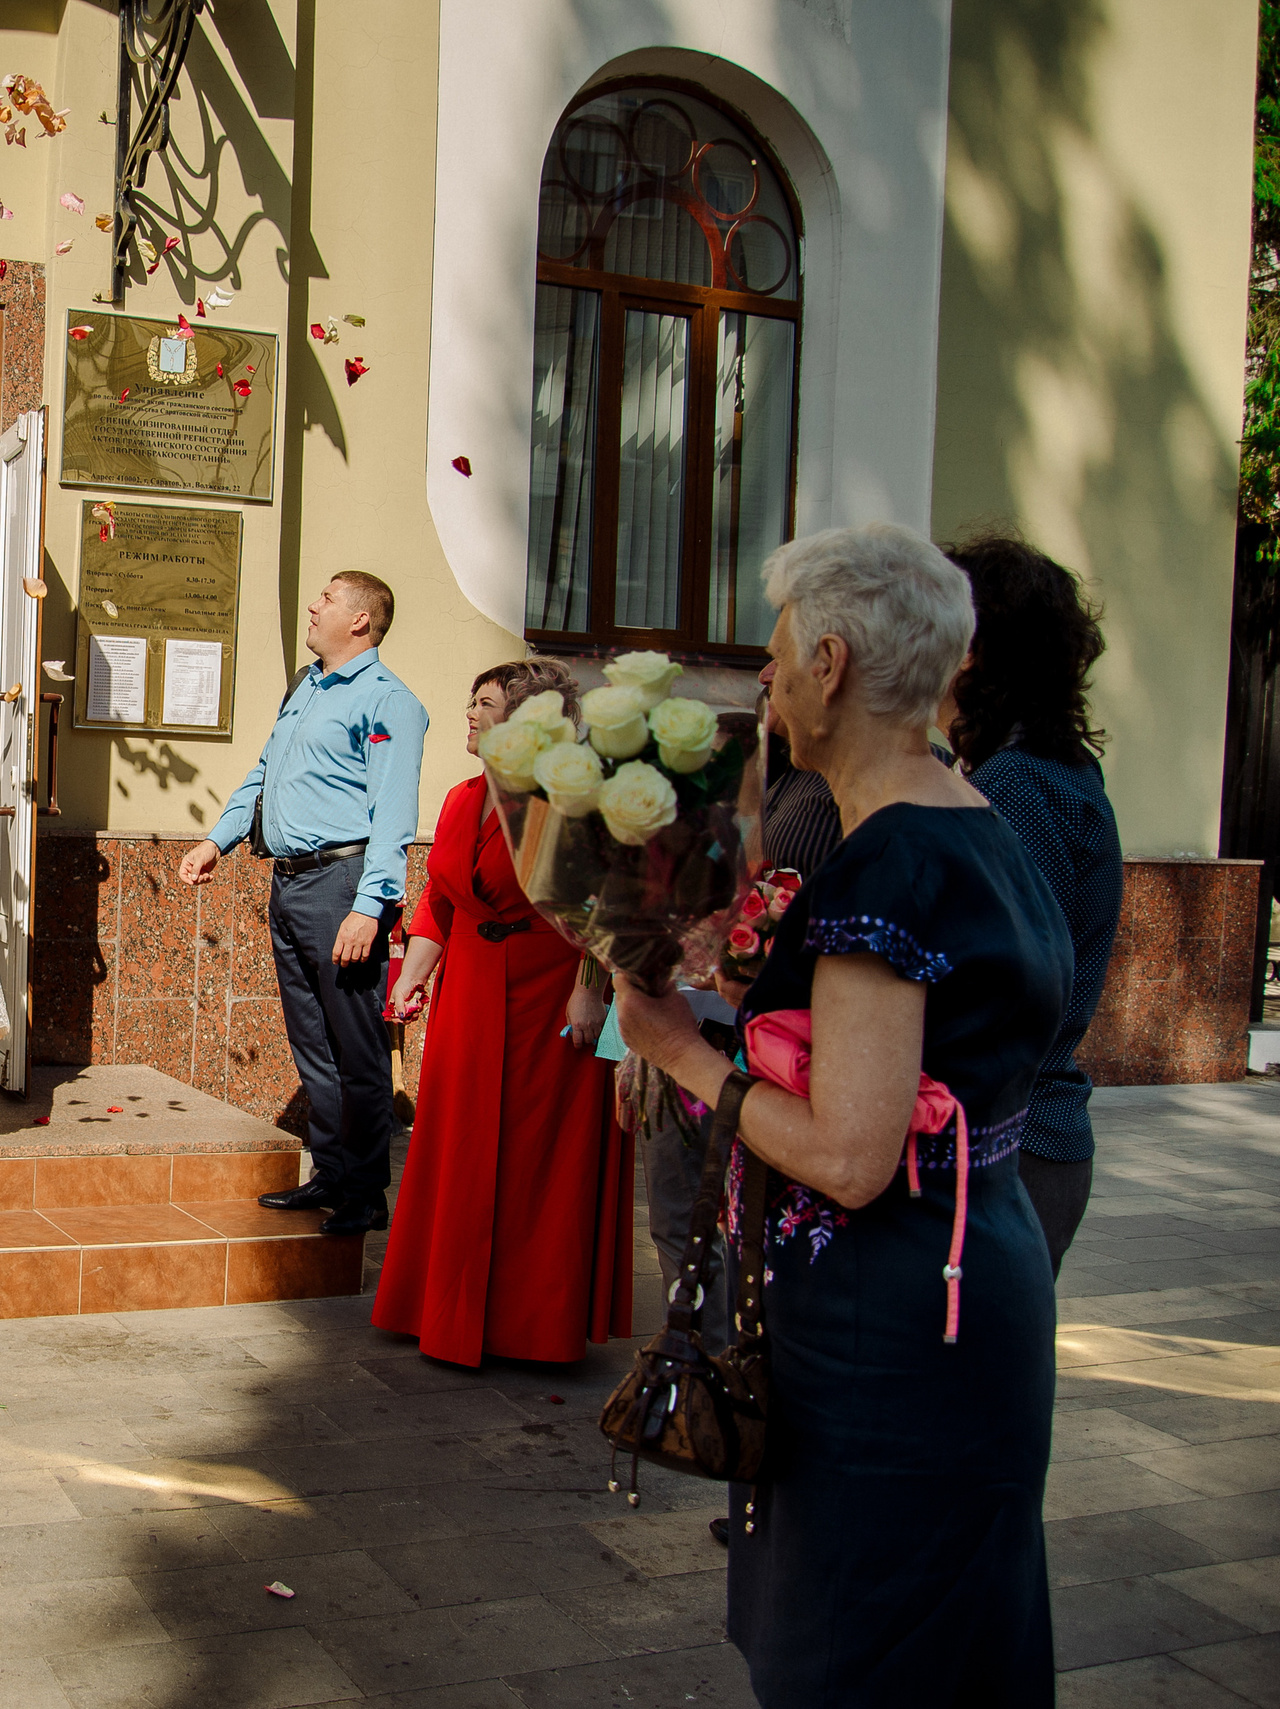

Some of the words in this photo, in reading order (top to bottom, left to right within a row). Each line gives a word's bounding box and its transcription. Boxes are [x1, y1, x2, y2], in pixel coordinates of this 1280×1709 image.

[135, 383, 205, 400] Управление
[109, 403, 159, 414] Правительства
[160, 407, 201, 418] Саратовской
[202, 412, 227, 420] области
[100, 416, 208, 434] СПЕЦИАЛИЗИРОВАННЫЙ
[210, 427, 238, 437] ОТДЕЛ
[94, 425, 181, 441] ГОСУДАРСТВЕННОЙ
[183, 434, 245, 447] РЕГИСТРАЦИИ
[91, 435, 120, 444] АКТОВ
[122, 437, 193, 451] ГРАЖДАНСКОГО
[194, 444, 247, 456] СОСТОЯНИЯ
[91, 472, 114, 482] Адрес:
[116, 474, 142, 483] 410002,
[233, 484, 241, 492] 22
[119, 551, 159, 562] РЕЖИМ
[162, 553, 206, 565] РАБОТЫ
[86, 569, 113, 578] Вторник
[118, 571, 144, 579] Суббота
[85, 585, 113, 593] Перерыв
[85, 602, 125, 611] Воскрье,
